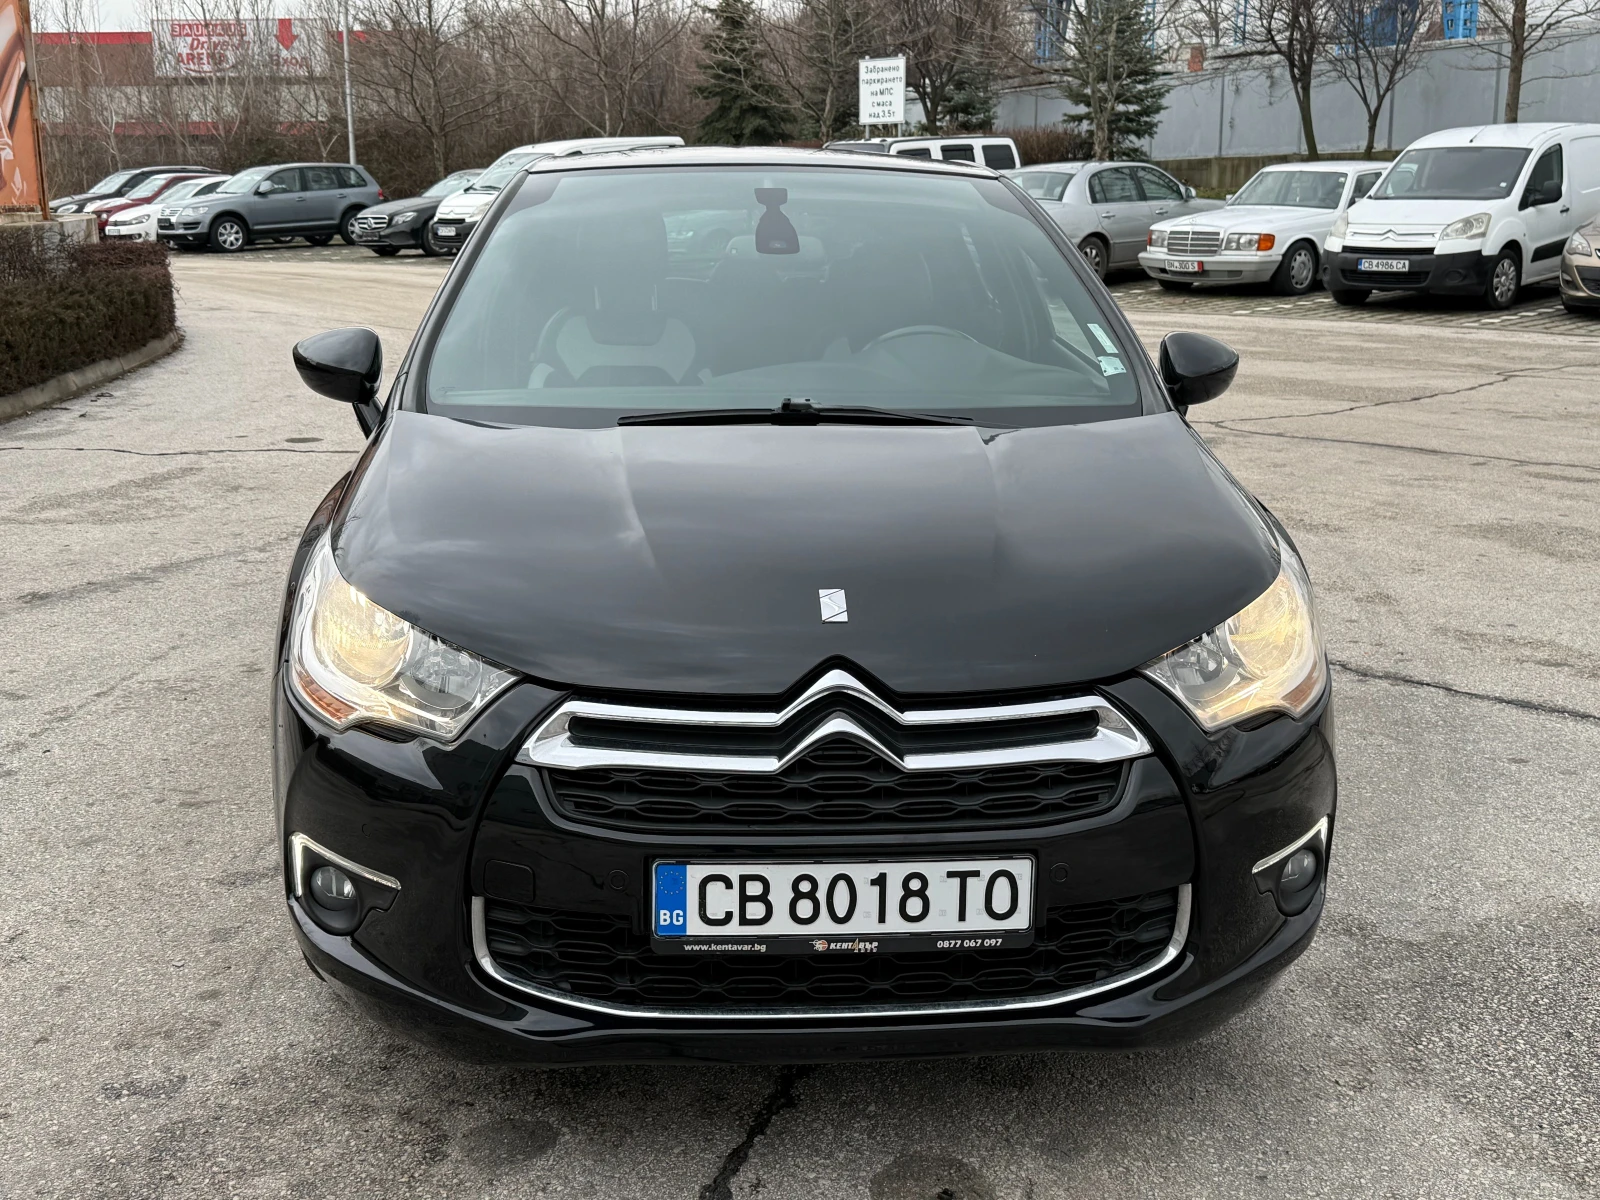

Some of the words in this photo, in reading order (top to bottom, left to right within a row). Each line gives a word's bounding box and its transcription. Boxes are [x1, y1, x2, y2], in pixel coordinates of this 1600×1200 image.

[865, 65, 900, 75] Забранено
[862, 77, 903, 86] паркирането
[879, 87, 894, 96] МПС
[1363, 260, 1374, 270] CB
[1374, 261, 1395, 270] 4986
[1395, 261, 1407, 271] CA
[698, 873, 773, 926] CB
[789, 871, 930, 926] 8018
[946, 869, 1019, 922] TO
[659, 910, 684, 925] BG
[683, 943, 767, 952] www.kentavar.bg
[937, 940, 961, 948] 0877
[984, 939, 1003, 947] 097
